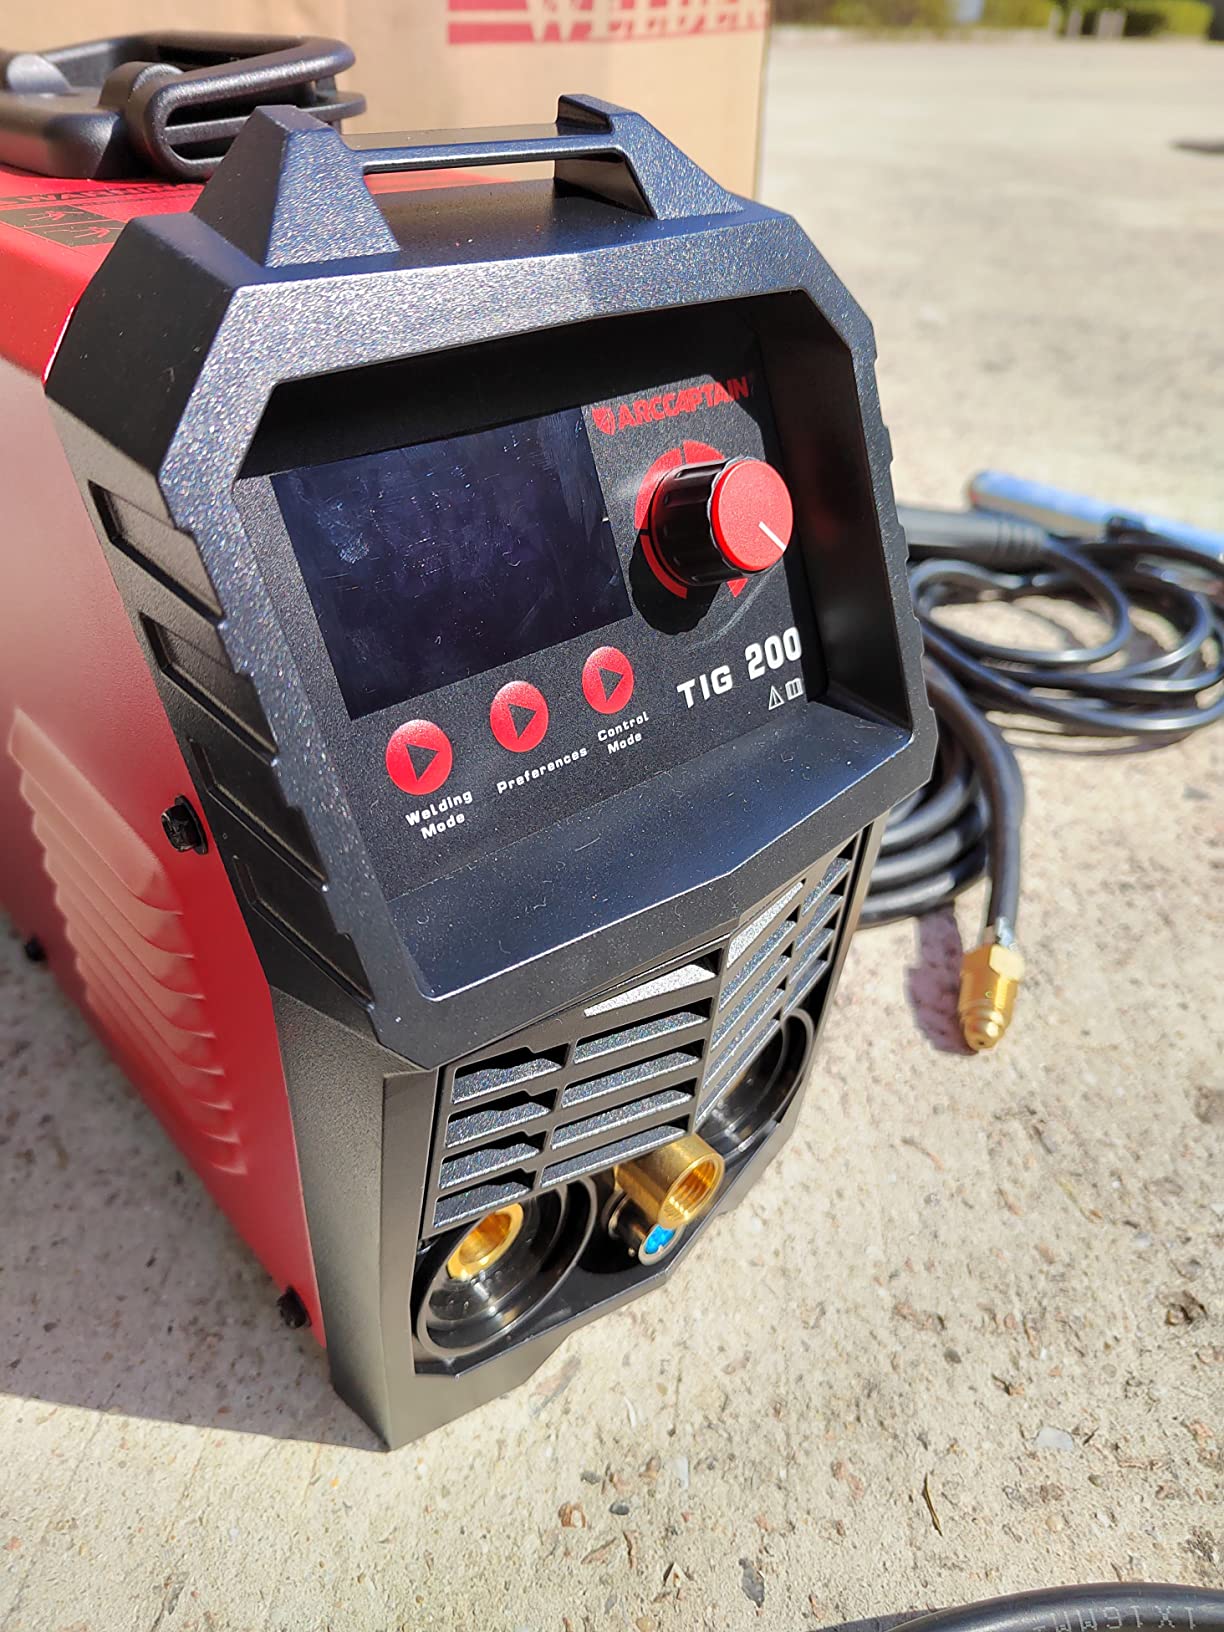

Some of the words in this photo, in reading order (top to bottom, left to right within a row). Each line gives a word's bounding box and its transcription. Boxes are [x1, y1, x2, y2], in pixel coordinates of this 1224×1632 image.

[617, 376, 750, 431] ARCCAPTAIN
[676, 664, 734, 709] TIG
[744, 626, 802, 681] 200
[597, 710, 650, 742] Control
[606, 732, 643, 755] Mode
[496, 747, 588, 795] Preferences
[404, 790, 474, 826] Welding
[419, 813, 466, 840] Mode
